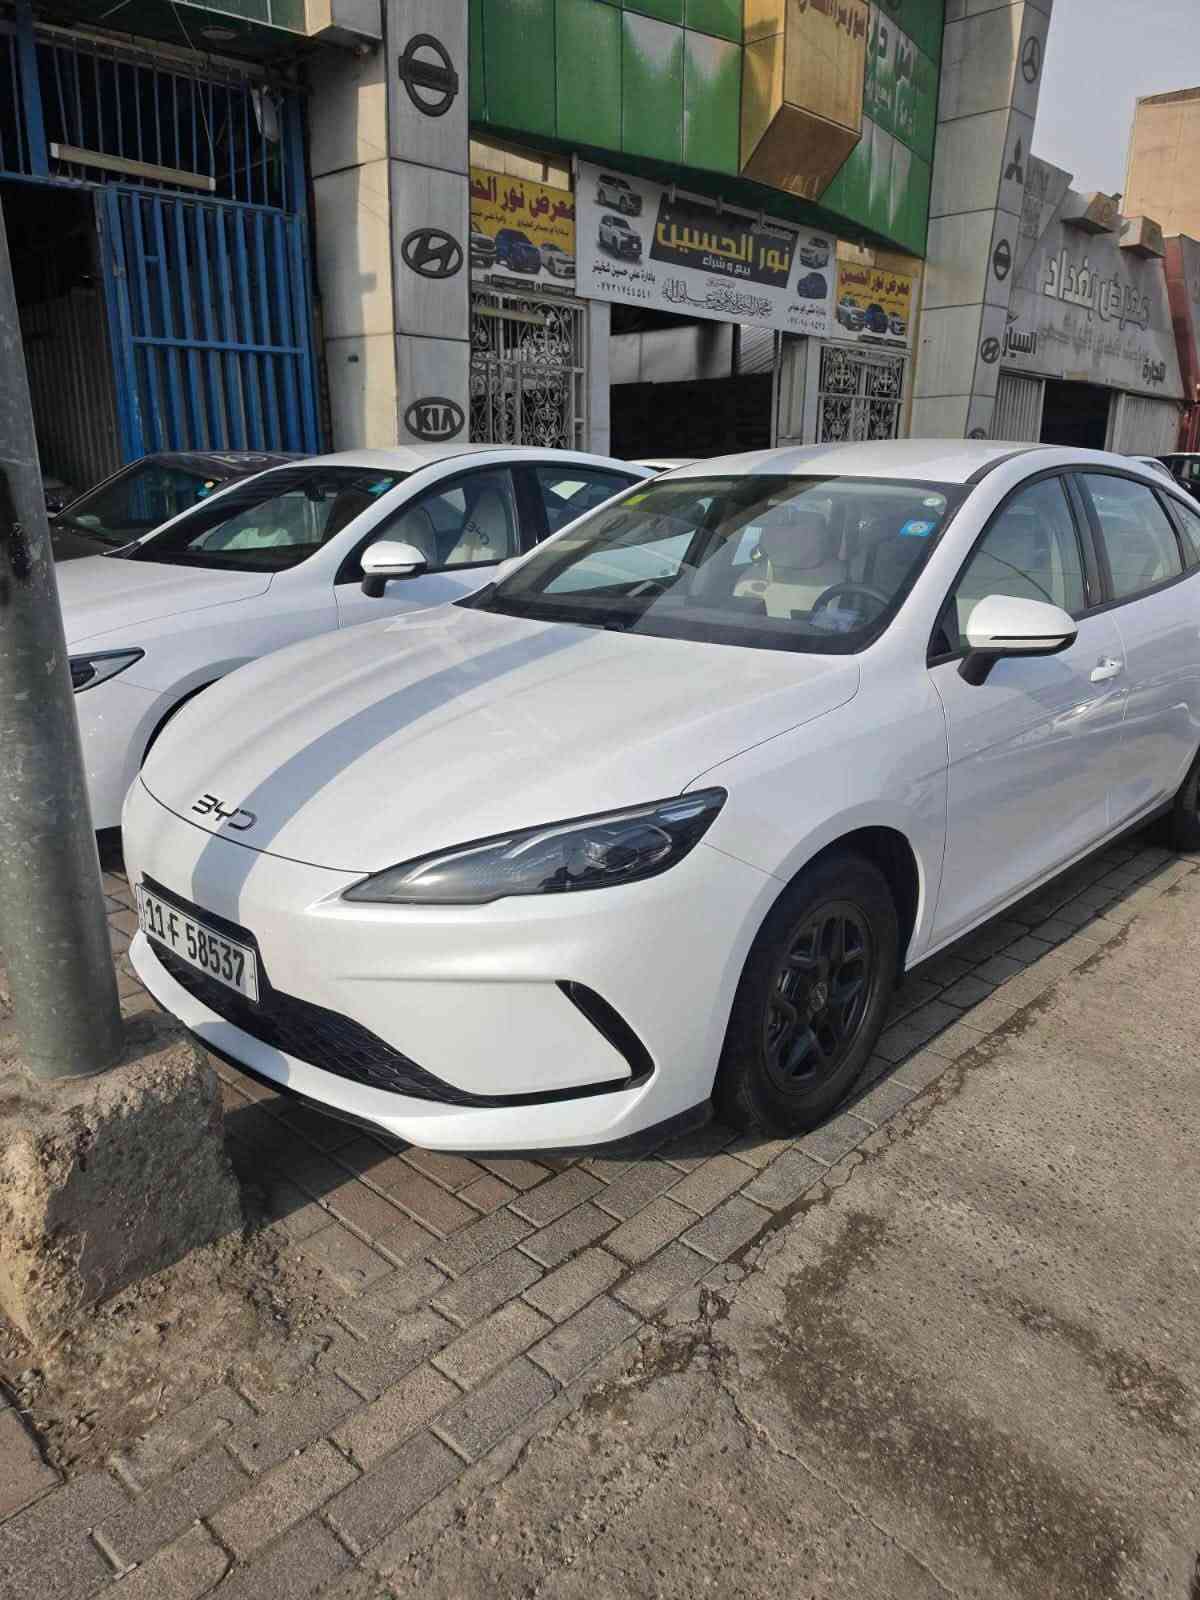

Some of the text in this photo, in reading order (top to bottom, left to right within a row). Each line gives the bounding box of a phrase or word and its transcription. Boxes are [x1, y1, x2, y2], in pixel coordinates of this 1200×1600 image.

[500, 182, 525, 213] نور
[656, 213, 754, 264] الحسين
[758, 247, 790, 273] نور
[1042, 248, 1151, 332] معرض بغداد
[415, 407, 457, 432] KIA
[191, 793, 259, 832] BYD
[145, 898, 166, 941] 11
[168, 911, 180, 947] F
[185, 921, 246, 987] 58537
